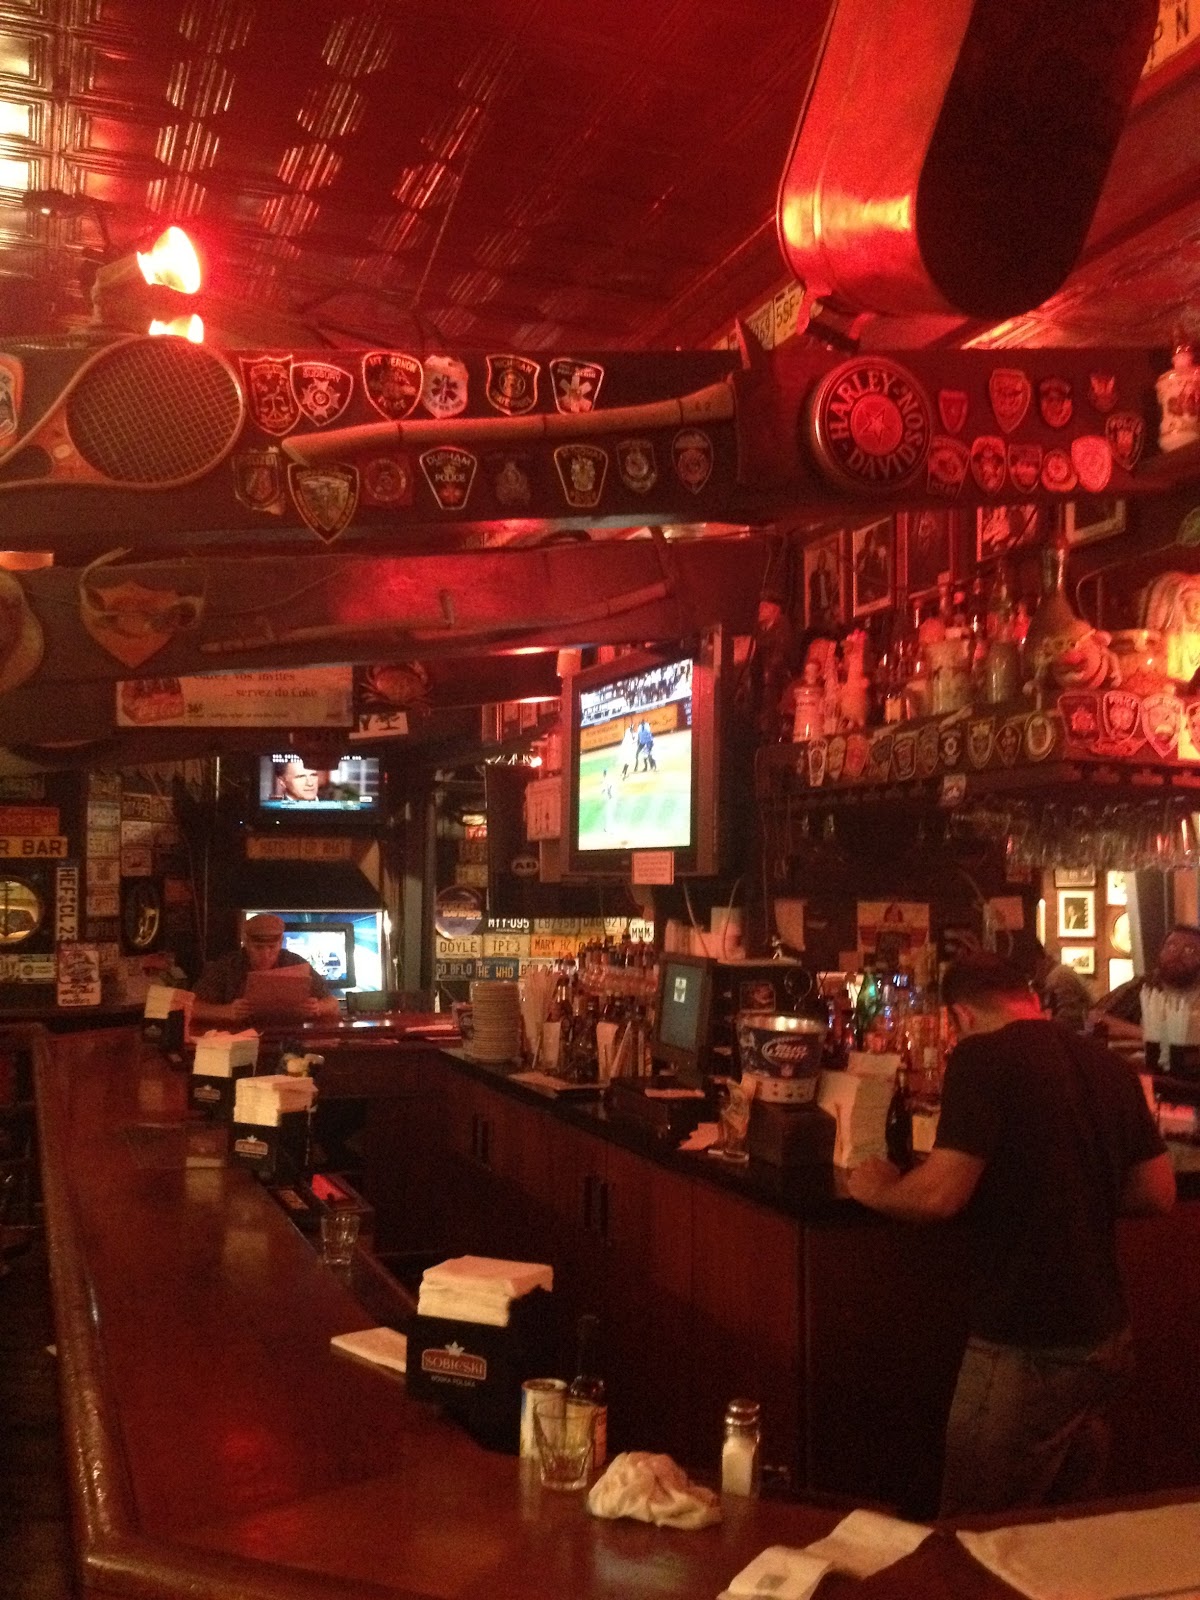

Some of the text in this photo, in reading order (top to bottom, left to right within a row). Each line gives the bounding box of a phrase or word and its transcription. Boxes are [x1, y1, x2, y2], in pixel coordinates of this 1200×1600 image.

[828, 369, 896, 441] HARLEY
[434, 473, 466, 482] POLICE
[235, 688, 271, 698] servez
[291, 687, 318, 698] Coke
[22, 839, 62, 855] BAR
[439, 941, 478, 953] DOYLE
[534, 938, 556, 950] MARY
[495, 966, 514, 979] WHO
[425, 1355, 484, 1376] SOBIESKI
